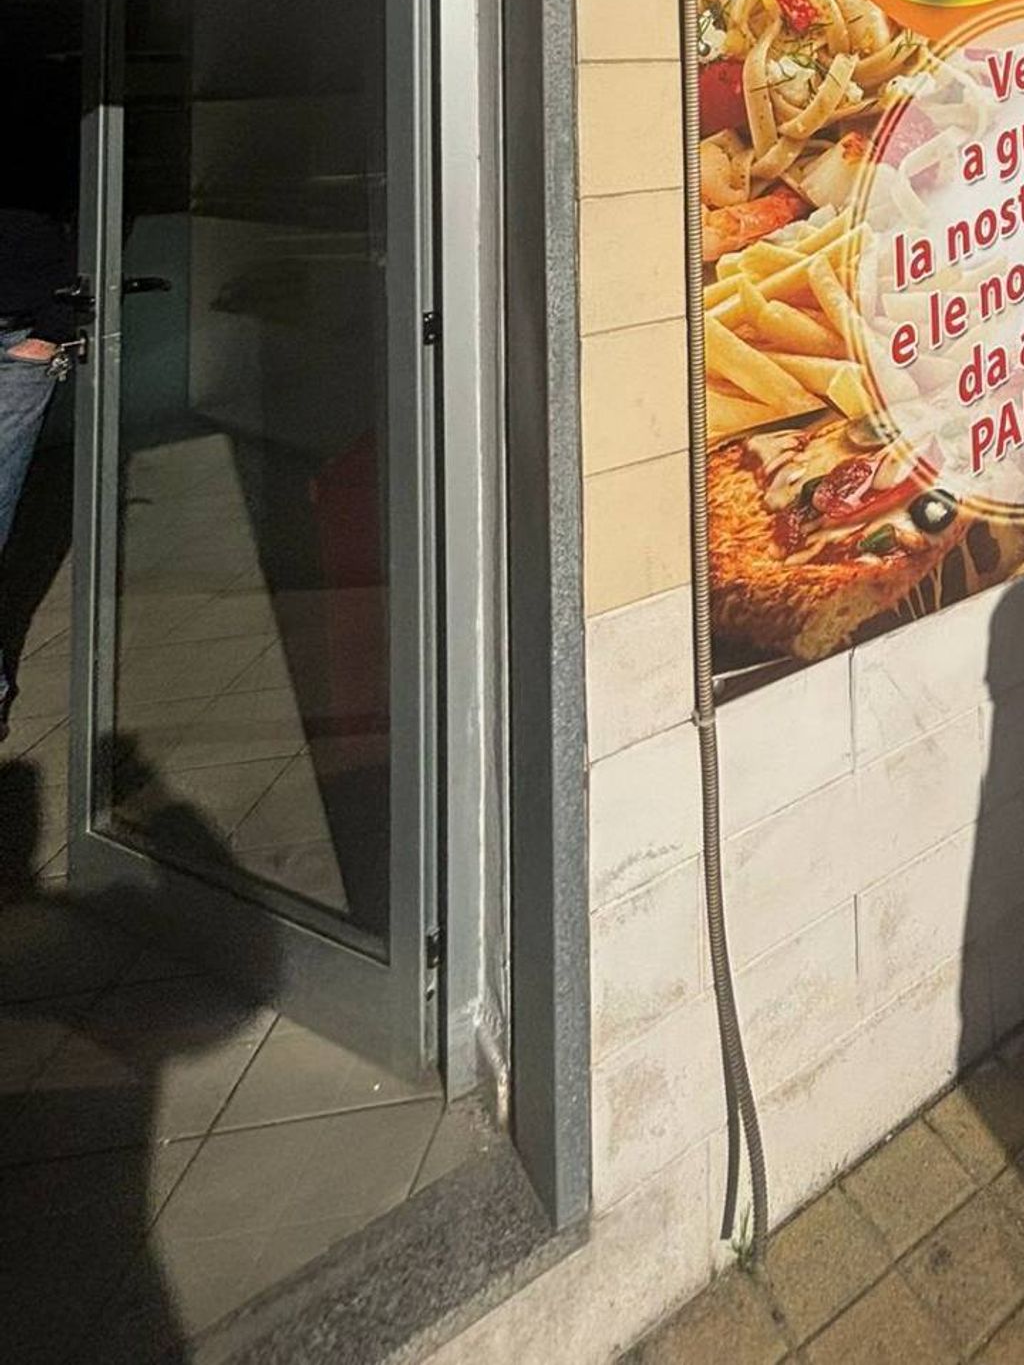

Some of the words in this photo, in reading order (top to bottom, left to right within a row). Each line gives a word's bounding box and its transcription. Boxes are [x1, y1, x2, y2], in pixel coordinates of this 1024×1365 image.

[961, 141, 984, 183] a
[895, 234, 933, 289] la
[891, 321, 917, 366] e
[928, 290, 968, 349] le
[957, 345, 1009, 404] da
